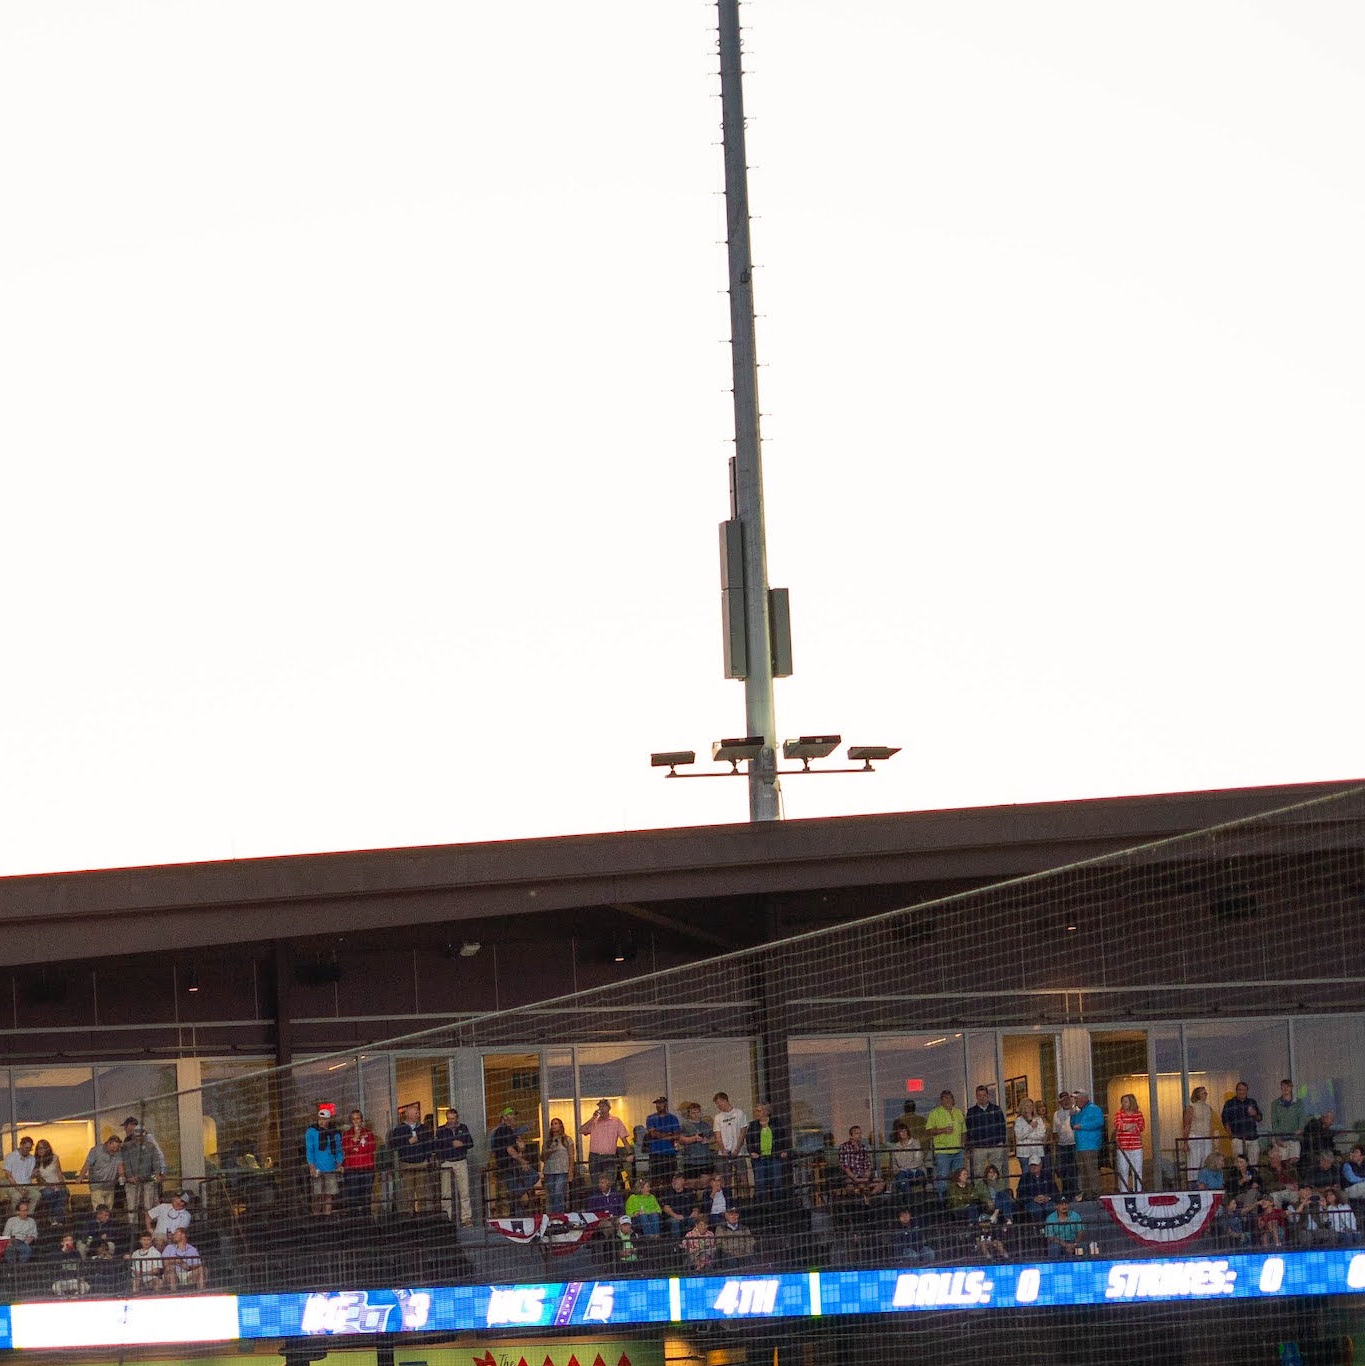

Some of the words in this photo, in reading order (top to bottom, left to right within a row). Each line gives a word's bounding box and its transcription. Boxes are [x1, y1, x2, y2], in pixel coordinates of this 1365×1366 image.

[892, 1272, 994, 1307] BALLS:
[1016, 1268, 1040, 1302] 0
[1105, 1261, 1236, 1298] STRIKES:
[1259, 1257, 1284, 1292] 0
[404, 1294, 430, 1328] 3
[590, 1285, 614, 1320] 5
[714, 1279, 778, 1315] 4TH
